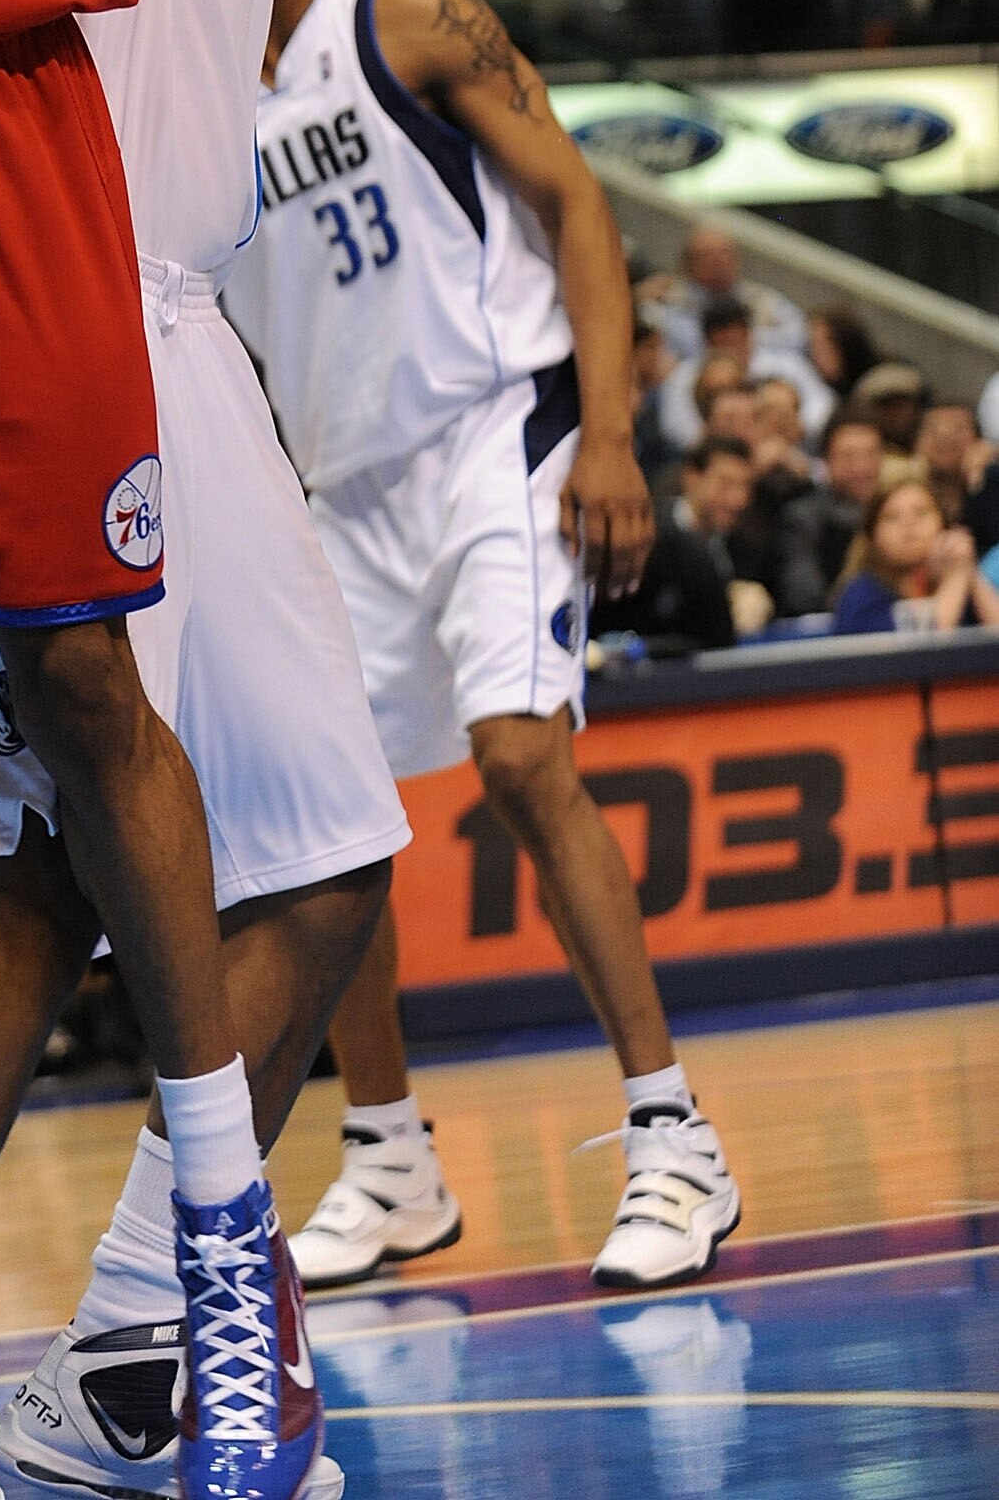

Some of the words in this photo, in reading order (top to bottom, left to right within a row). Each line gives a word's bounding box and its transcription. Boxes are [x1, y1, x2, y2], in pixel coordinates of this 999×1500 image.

[260, 107, 371, 211] LLAS
[314, 182, 399, 287] 33
[151, 1324, 180, 1343] NIKE
